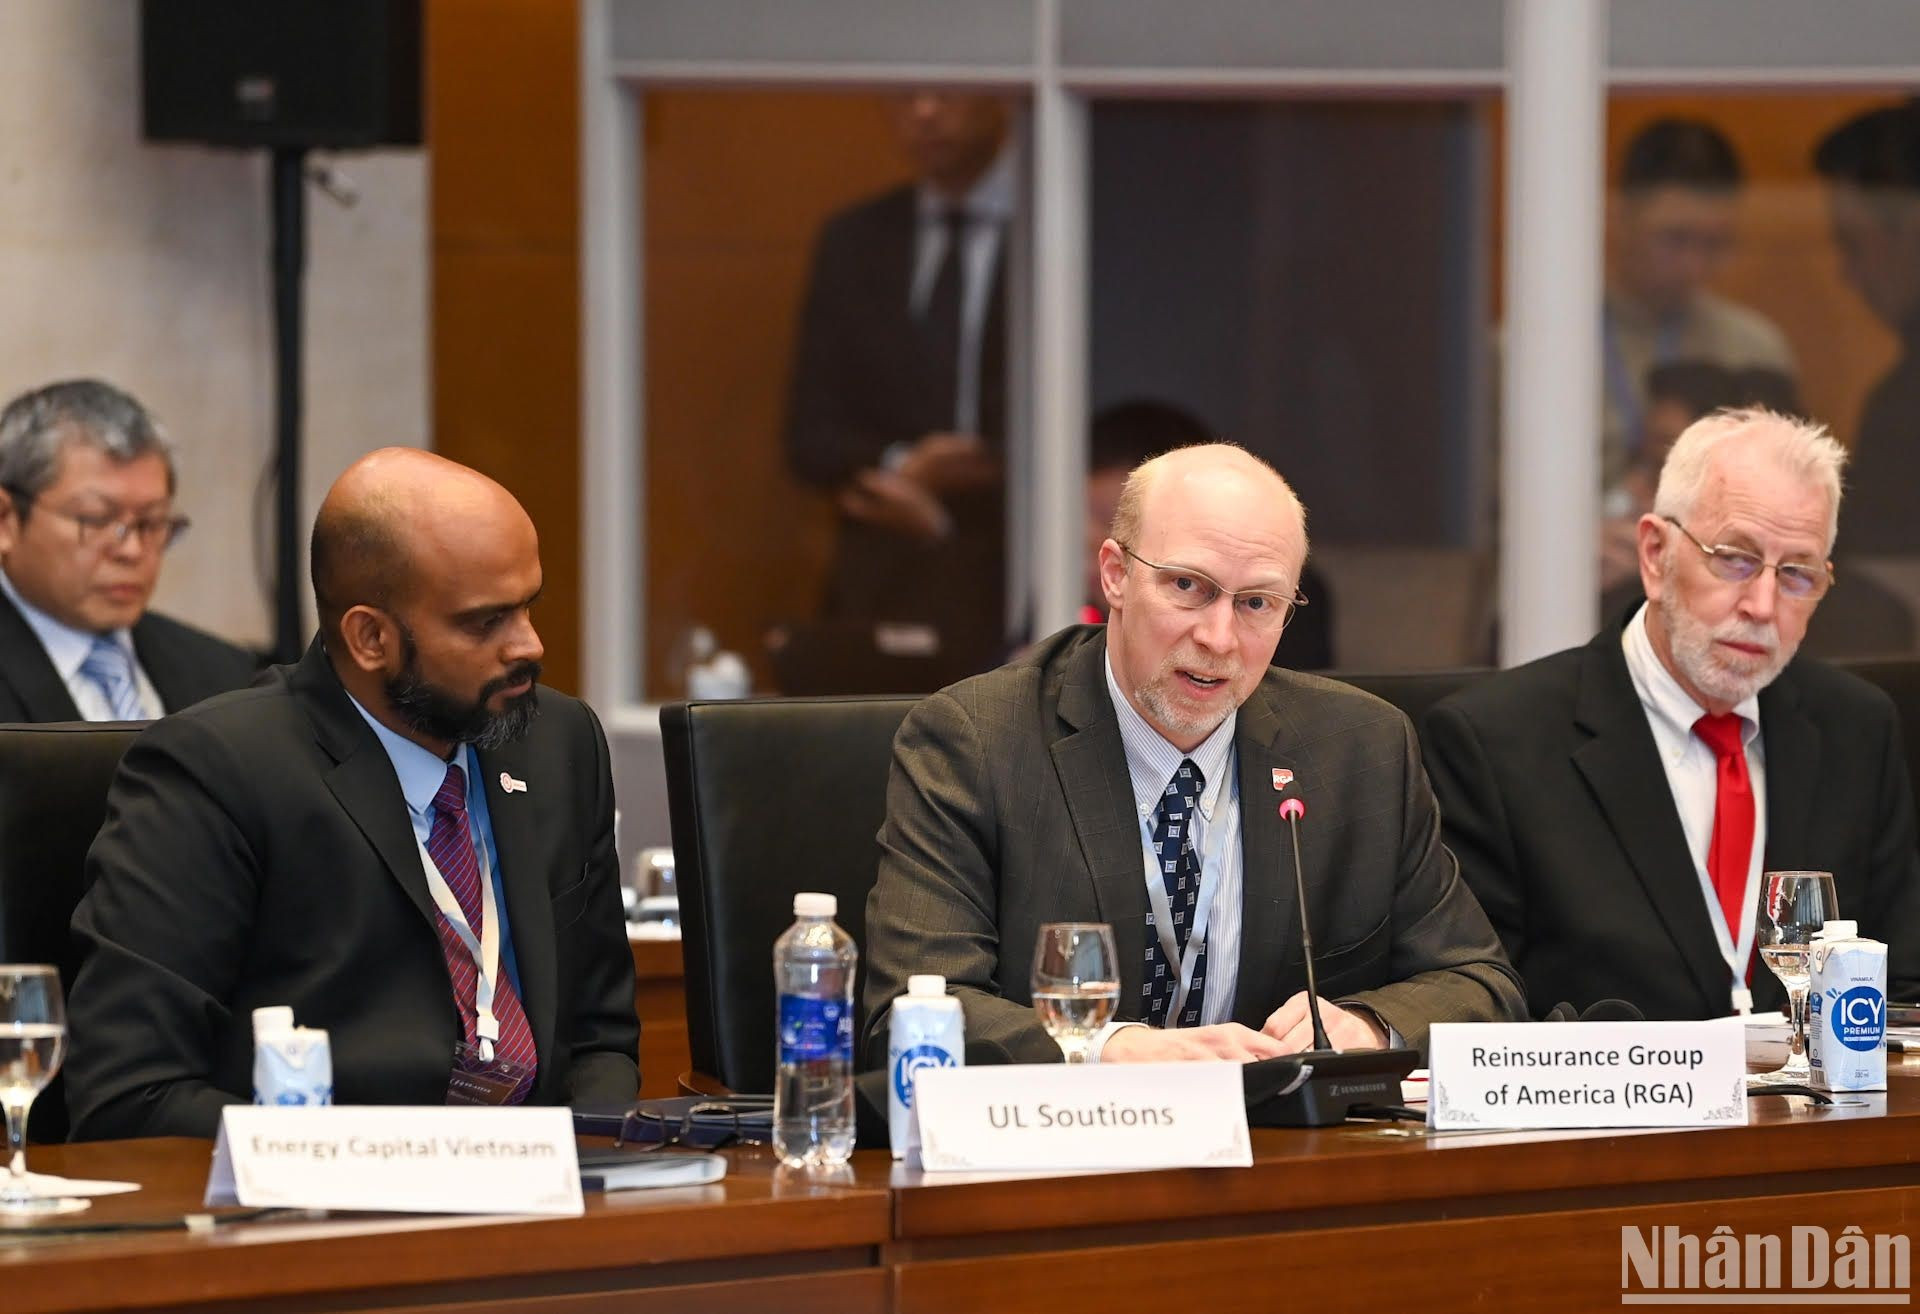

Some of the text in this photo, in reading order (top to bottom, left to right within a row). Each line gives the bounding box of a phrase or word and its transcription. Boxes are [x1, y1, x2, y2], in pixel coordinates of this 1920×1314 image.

[1841, 997, 1884, 1025] ICY
[1843, 1026, 1881, 1035] PREMIUM
[1472, 1045, 1704, 1070] Reinsurance Group
[1485, 1081, 1694, 1109] of America (RGA)
[988, 1101, 1175, 1129] UL Soutions
[251, 1135, 556, 1159] Energy Capital Vietnam
